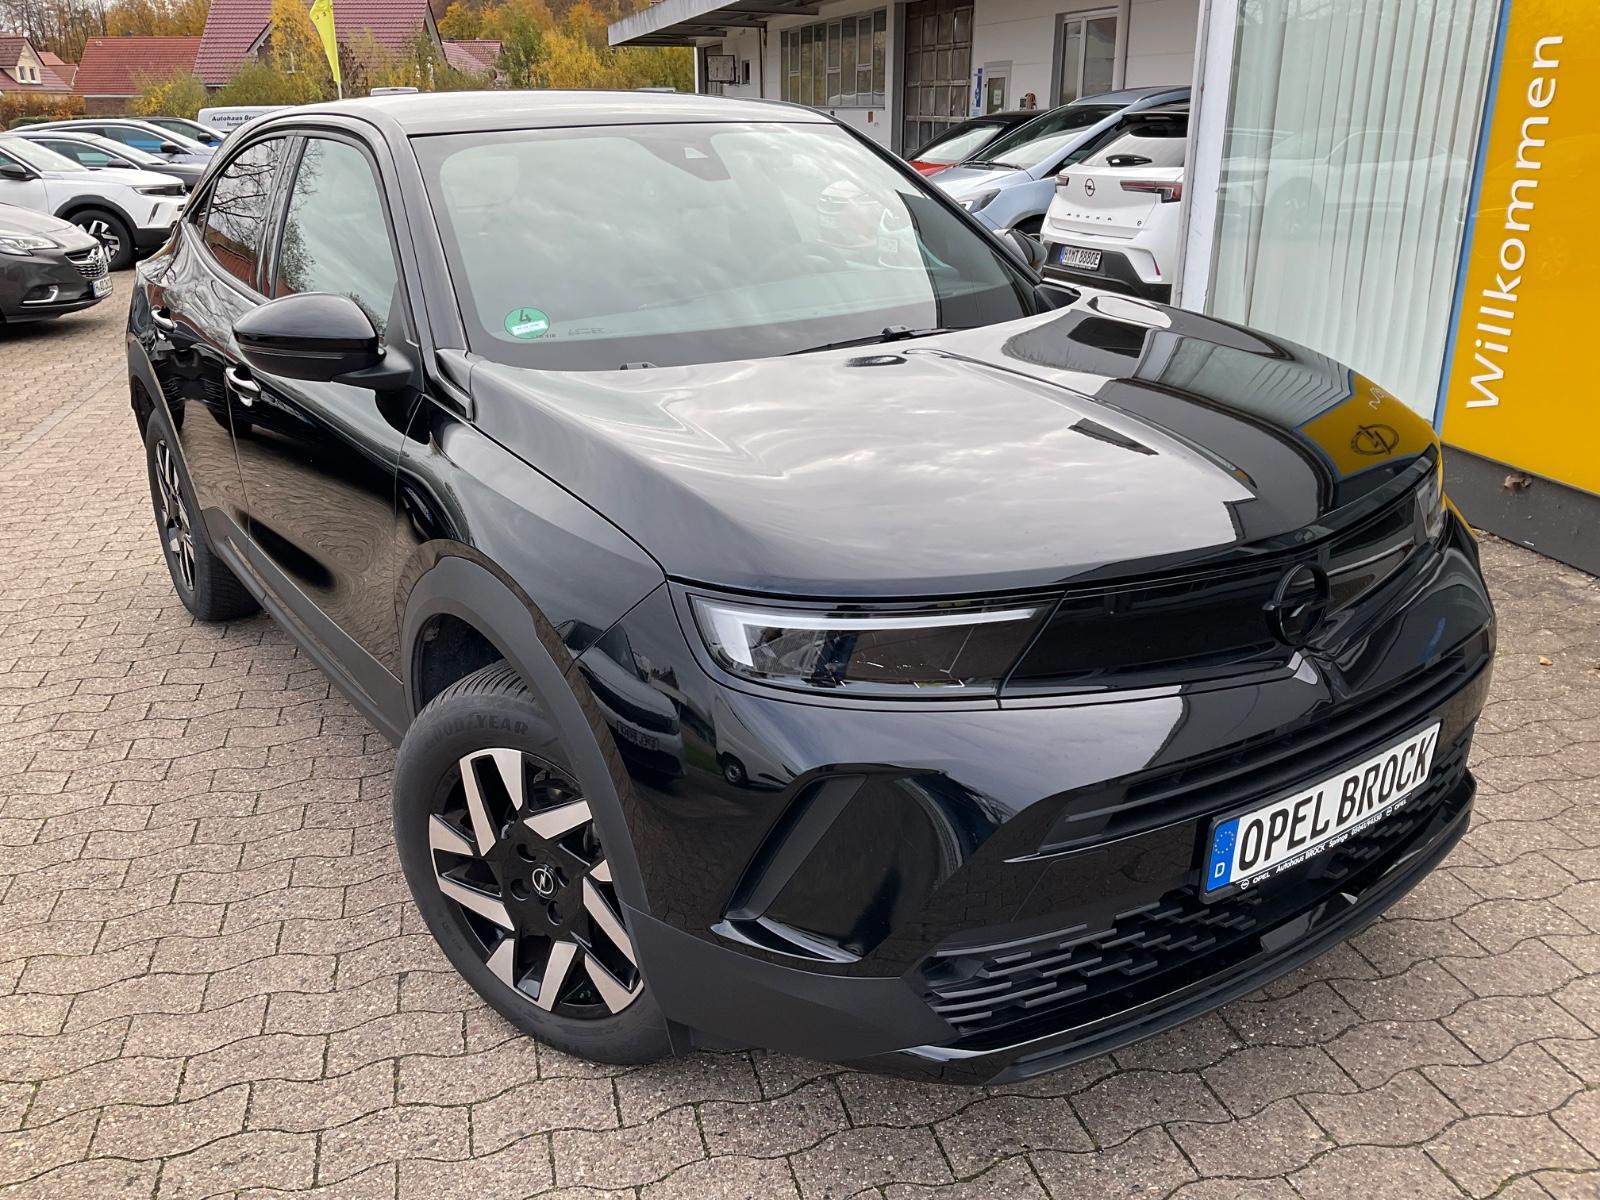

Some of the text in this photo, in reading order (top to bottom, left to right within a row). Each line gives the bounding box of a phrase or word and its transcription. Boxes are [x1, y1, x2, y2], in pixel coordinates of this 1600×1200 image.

[1464, 35, 1564, 408] Willkommen
[1239, 731, 1436, 872] OPEL BROCK
[1214, 861, 1226, 879] D
[1252, 872, 1271, 885] OPEL
[1276, 855, 1305, 874] Autohaus
[1305, 842, 1326, 860] BROCK
[1328, 833, 1349, 848] Springe
